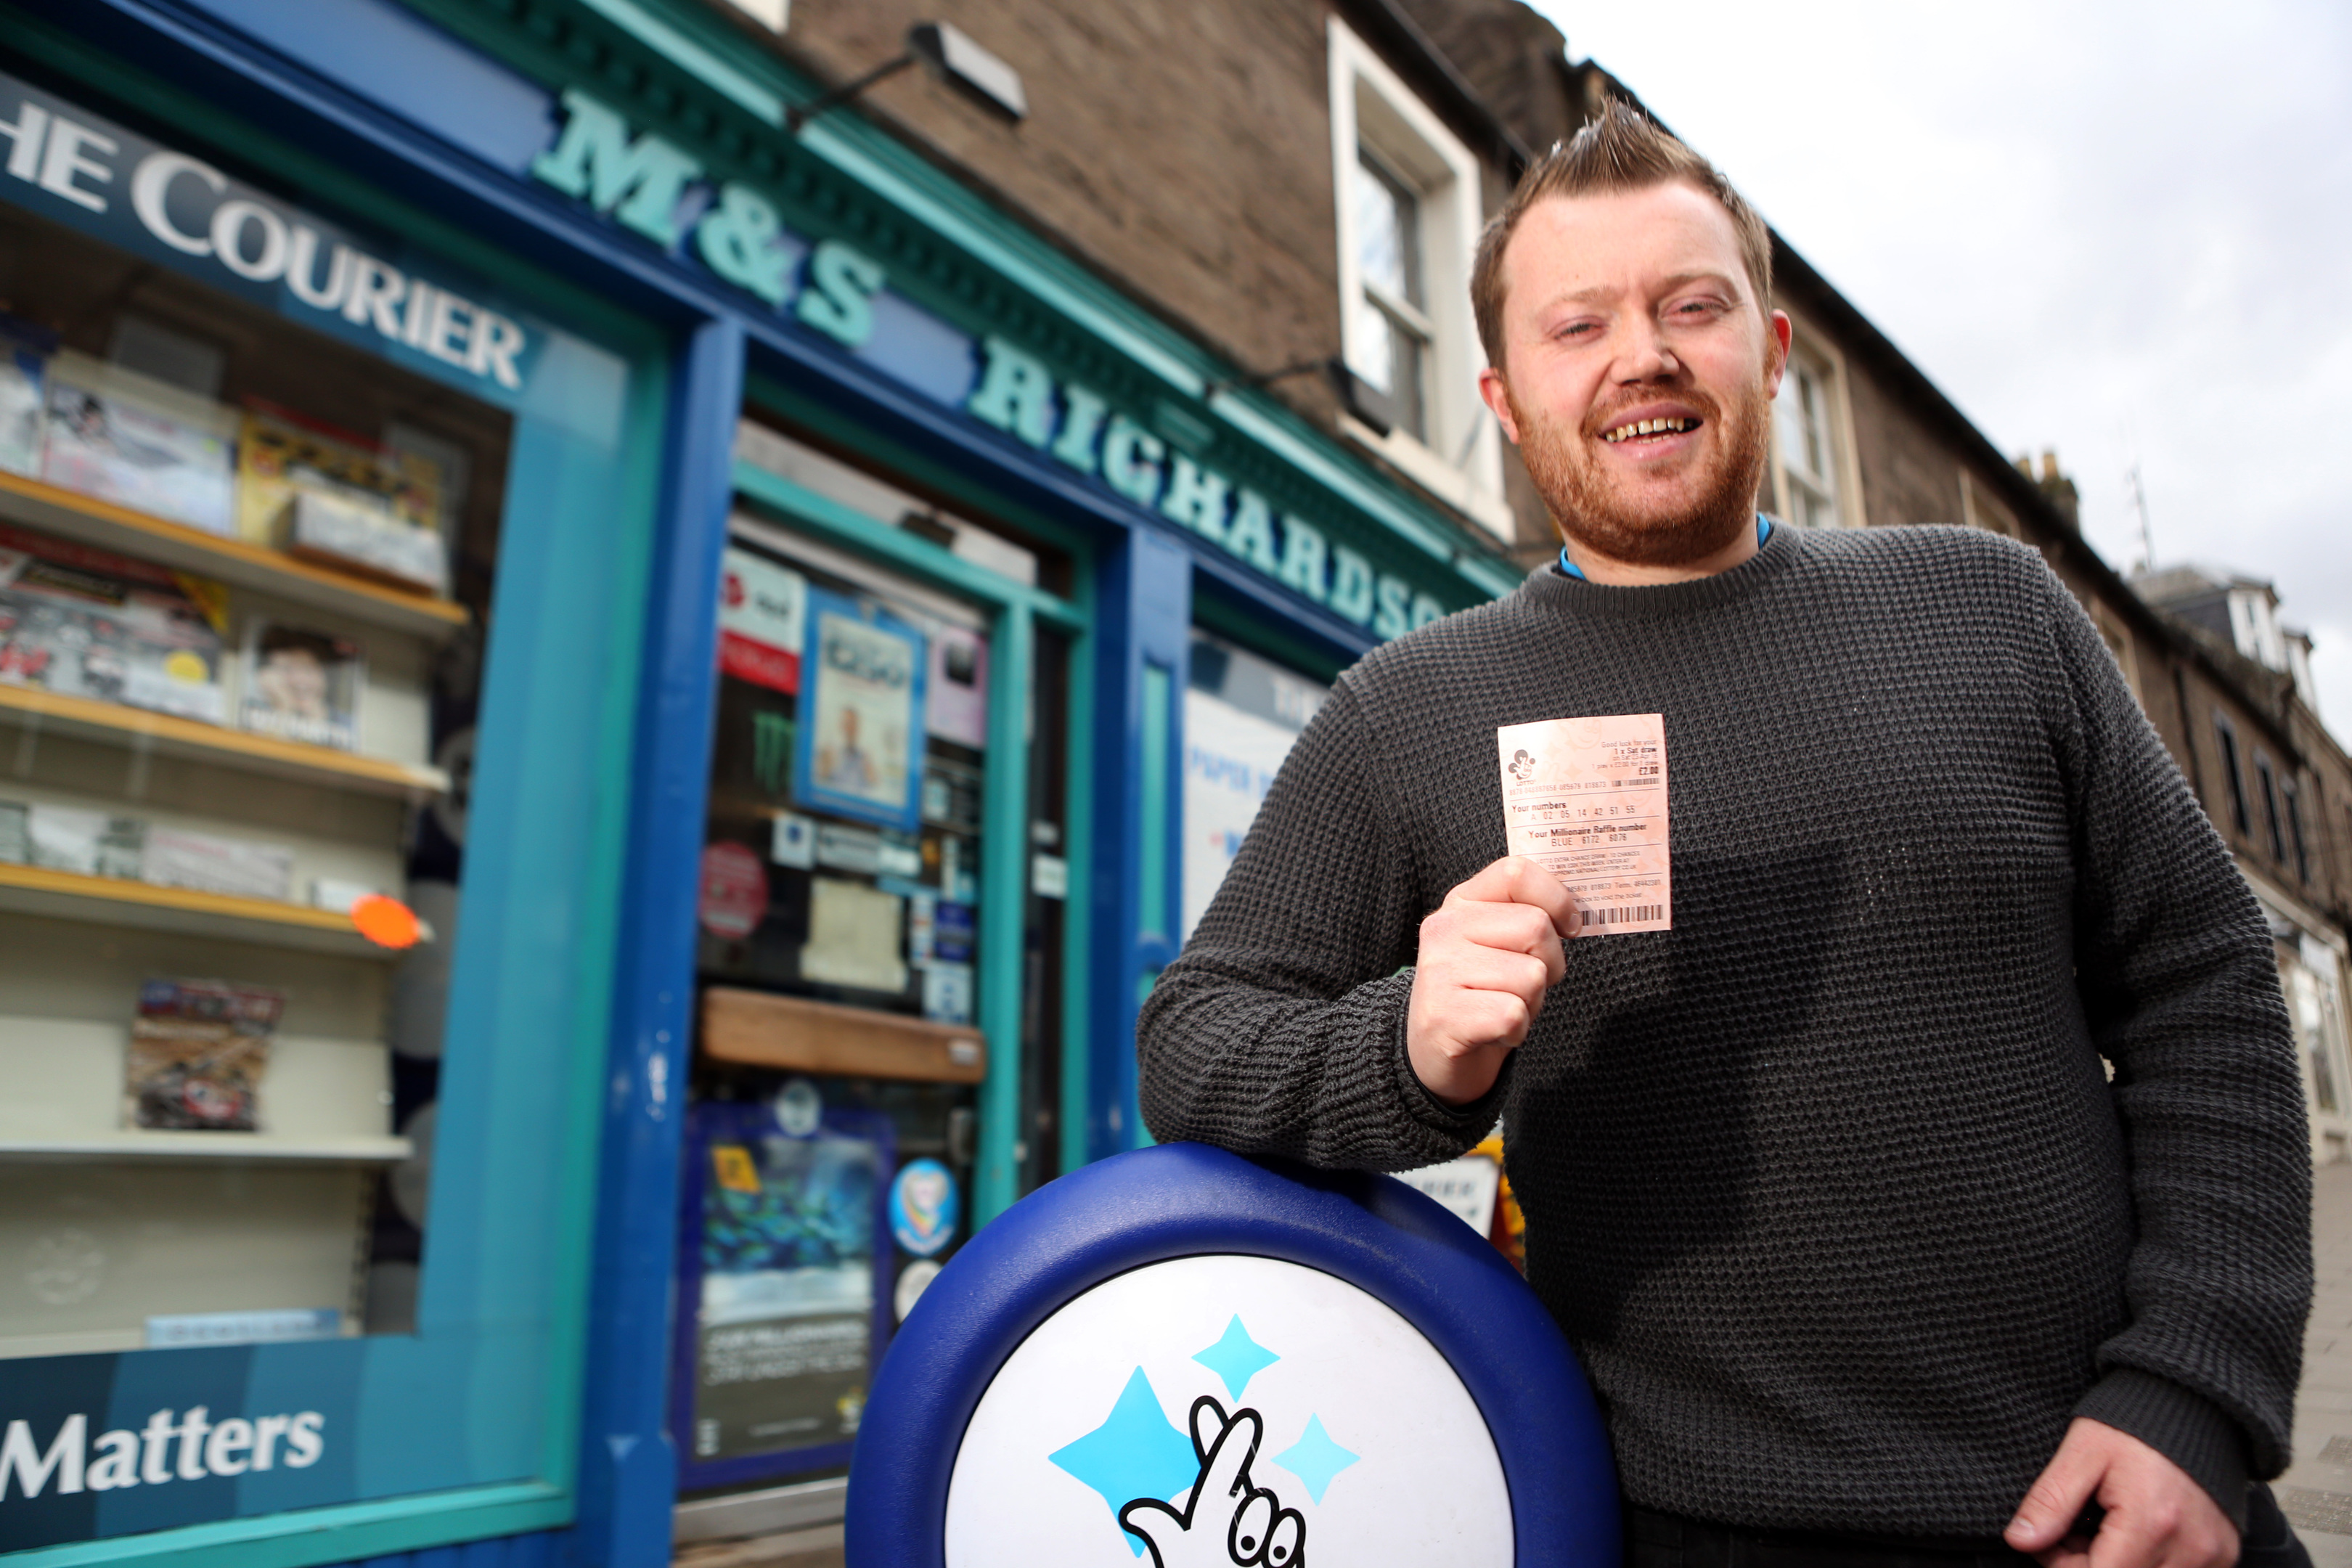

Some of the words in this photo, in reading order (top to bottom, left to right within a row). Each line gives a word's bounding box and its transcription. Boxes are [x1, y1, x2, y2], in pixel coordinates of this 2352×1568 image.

[534, 89, 885, 347] M&S
[130, 148, 526, 391] COURIER
[1638, 766, 1659, 775] £2.00
[1511, 804, 1530, 813] Your
[1532, 801, 1567, 812] numbers
[1543, 811, 1553, 820] 02
[1560, 809, 1571, 819] 05
[1577, 808, 1588, 817] 14
[1593, 807, 1604, 817] 42
[1609, 806, 1620, 815] 51
[1625, 804, 1636, 814] 55
[1528, 830, 1548, 838] Your
[1550, 828, 1592, 837] Millionaire
[1593, 825, 1617, 834] Raffle
[1618, 822, 1648, 833] number
[1551, 837, 1574, 847] BLUE
[1582, 835, 1601, 844] 6172
[0, 1403, 326, 1501] Matters
